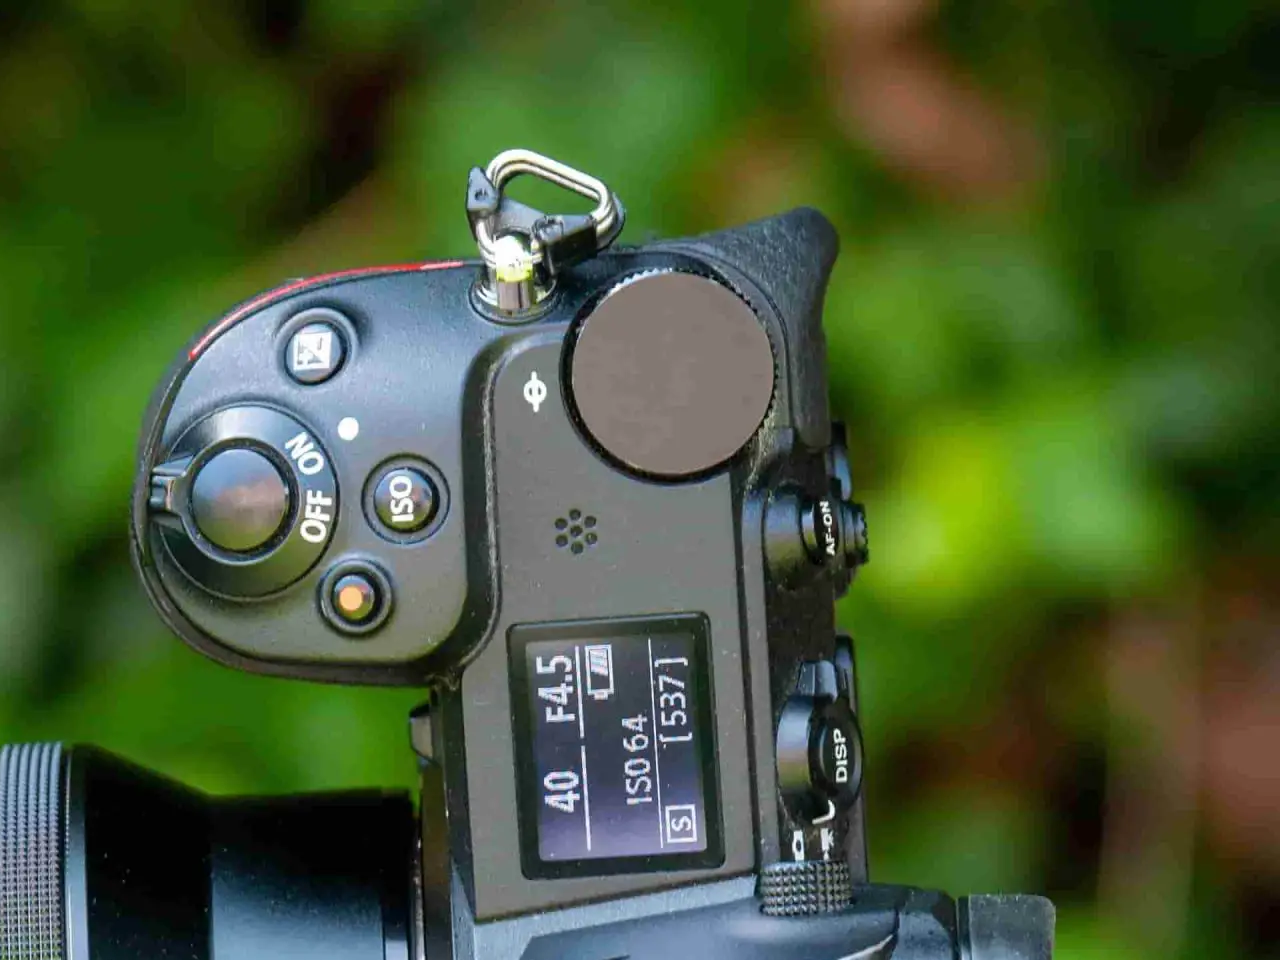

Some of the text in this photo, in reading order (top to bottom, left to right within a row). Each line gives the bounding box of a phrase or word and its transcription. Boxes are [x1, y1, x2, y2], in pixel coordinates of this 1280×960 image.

[284, 430, 325, 476] ON
[299, 489, 333, 544] OFF
[388, 475, 414, 523] ISO
[820, 501, 836, 556] AF-ON
[535, 655, 581, 813] 40 F4.5
[621, 714, 653, 805] ISO 64
[833, 728, 848, 783] DISP
